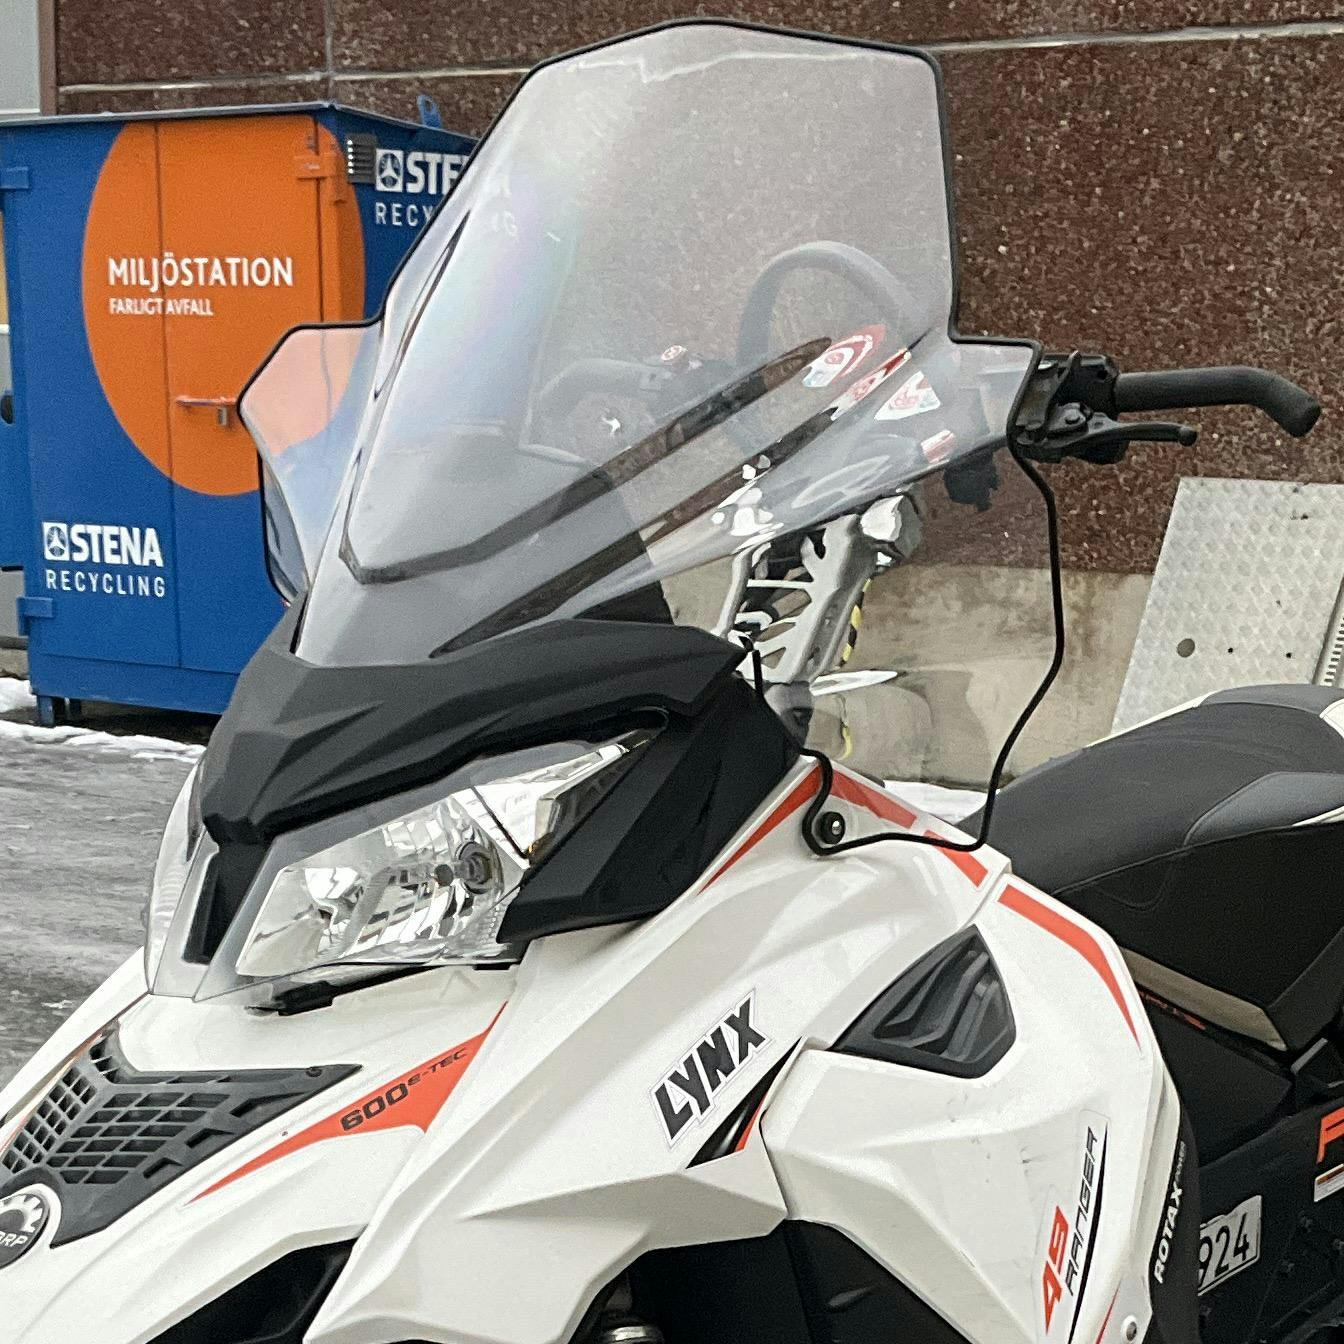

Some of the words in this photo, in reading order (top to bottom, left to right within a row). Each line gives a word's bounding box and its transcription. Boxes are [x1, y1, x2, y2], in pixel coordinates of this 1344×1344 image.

[406, 151, 471, 195] STE
[108, 252, 293, 293] MILJÖSTATION
[109, 298, 164, 315] FARLIGT
[165, 299, 213, 316] AVFALL
[70, 524, 164, 567] STENA
[46, 569, 165, 597] RECYCLING
[654, 997, 767, 1141] LYNX
[340, 1083, 409, 1131] 600
[1065, 1126, 1098, 1296] RANGER
[1154, 1181, 1183, 1284] ROTAX
[1043, 1206, 1069, 1335] 49
